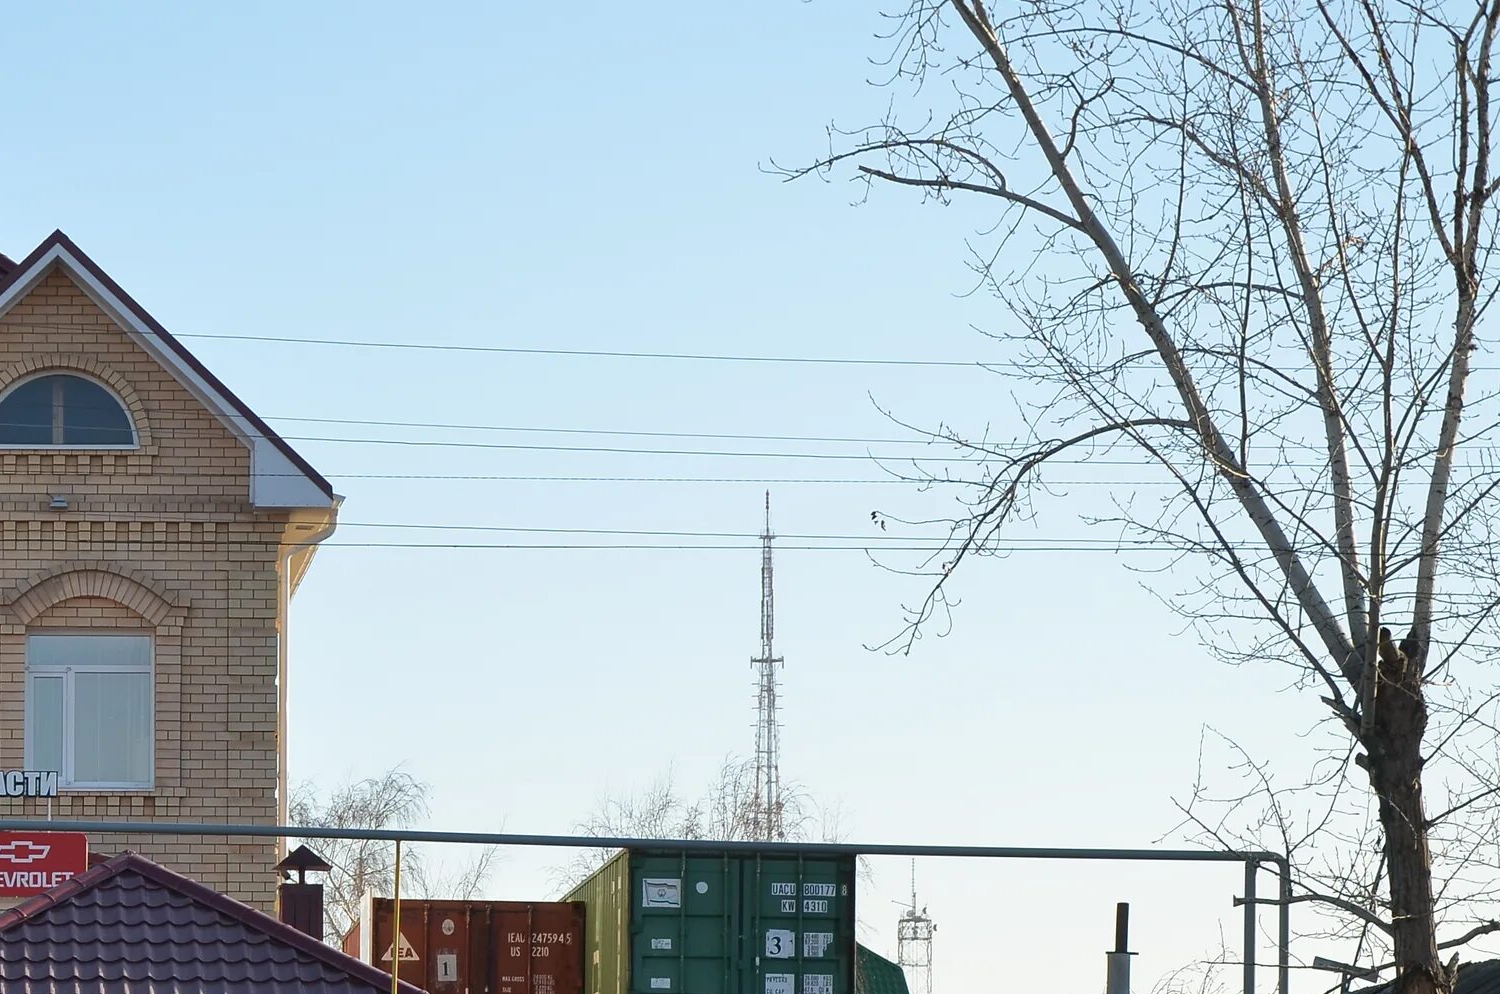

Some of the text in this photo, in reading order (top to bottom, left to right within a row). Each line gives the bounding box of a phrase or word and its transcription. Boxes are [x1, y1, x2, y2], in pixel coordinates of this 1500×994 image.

[772, 883, 796, 896] UACU
[803, 884, 836, 897] 800177
[781, 900, 828, 912] KW 4310
[510, 946, 549, 957] US 2210
[769, 936, 782, 955] 3
[442, 961, 449, 976] 1
